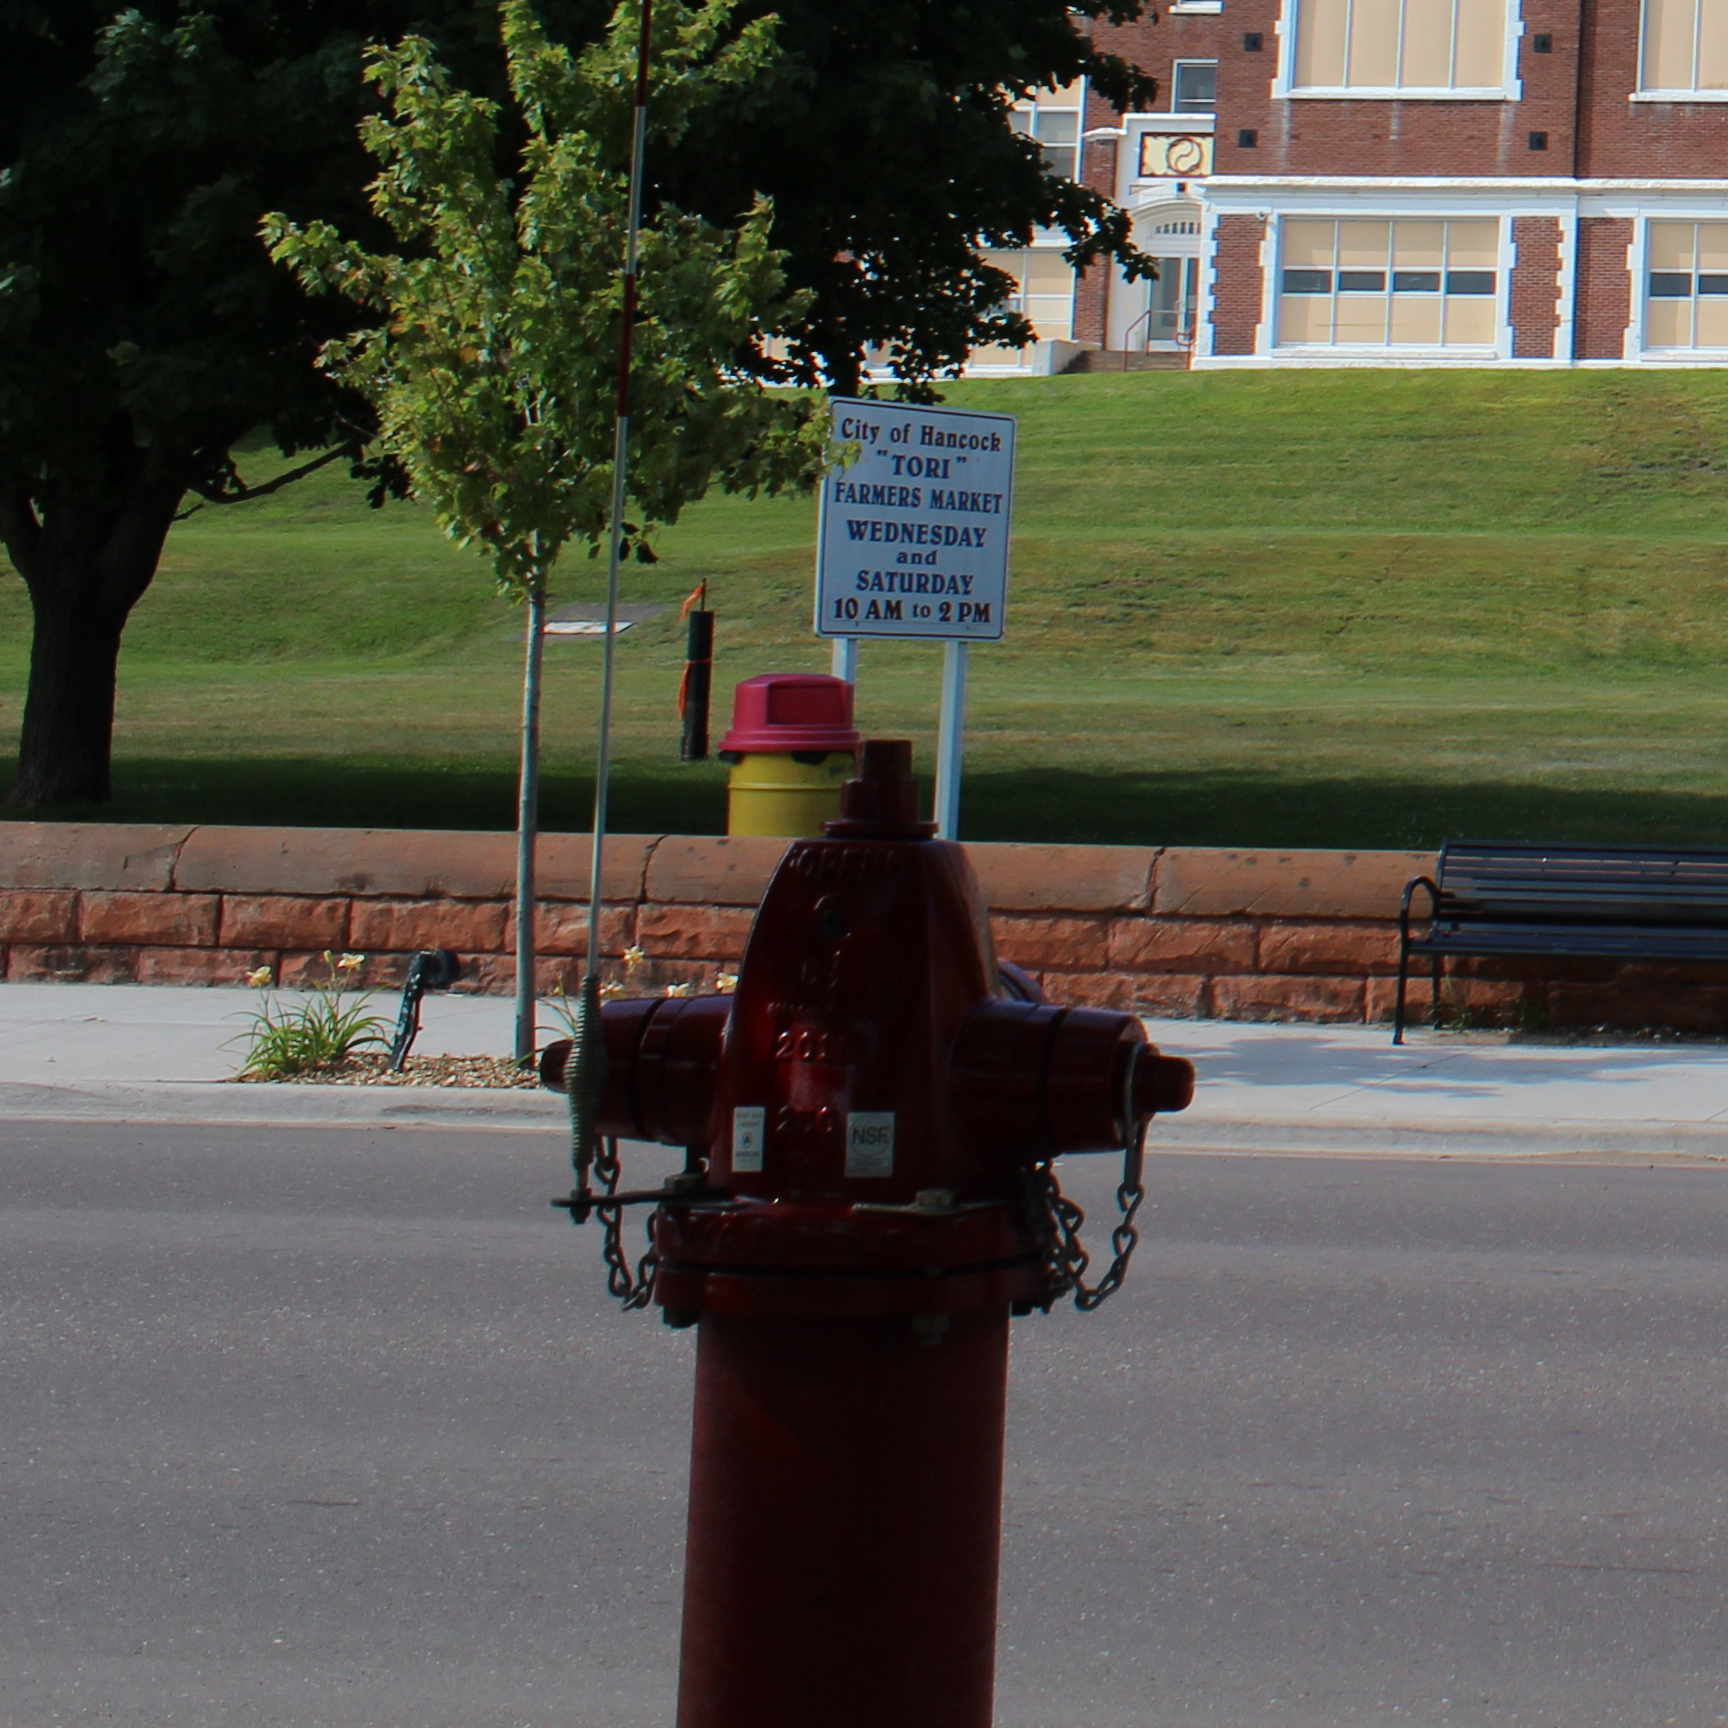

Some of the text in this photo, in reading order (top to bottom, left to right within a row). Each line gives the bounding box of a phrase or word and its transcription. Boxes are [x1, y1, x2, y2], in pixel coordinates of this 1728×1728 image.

[841, 417, 1001, 452] City of Hancock
[834, 481, 1003, 514] FARMERS MARKET
[847, 520, 987, 548] WEDNESDAY
[896, 549, 938, 566] and
[856, 569, 974, 595] SATURDAY
[834, 597, 992, 623] 10 AM to 2 PM
